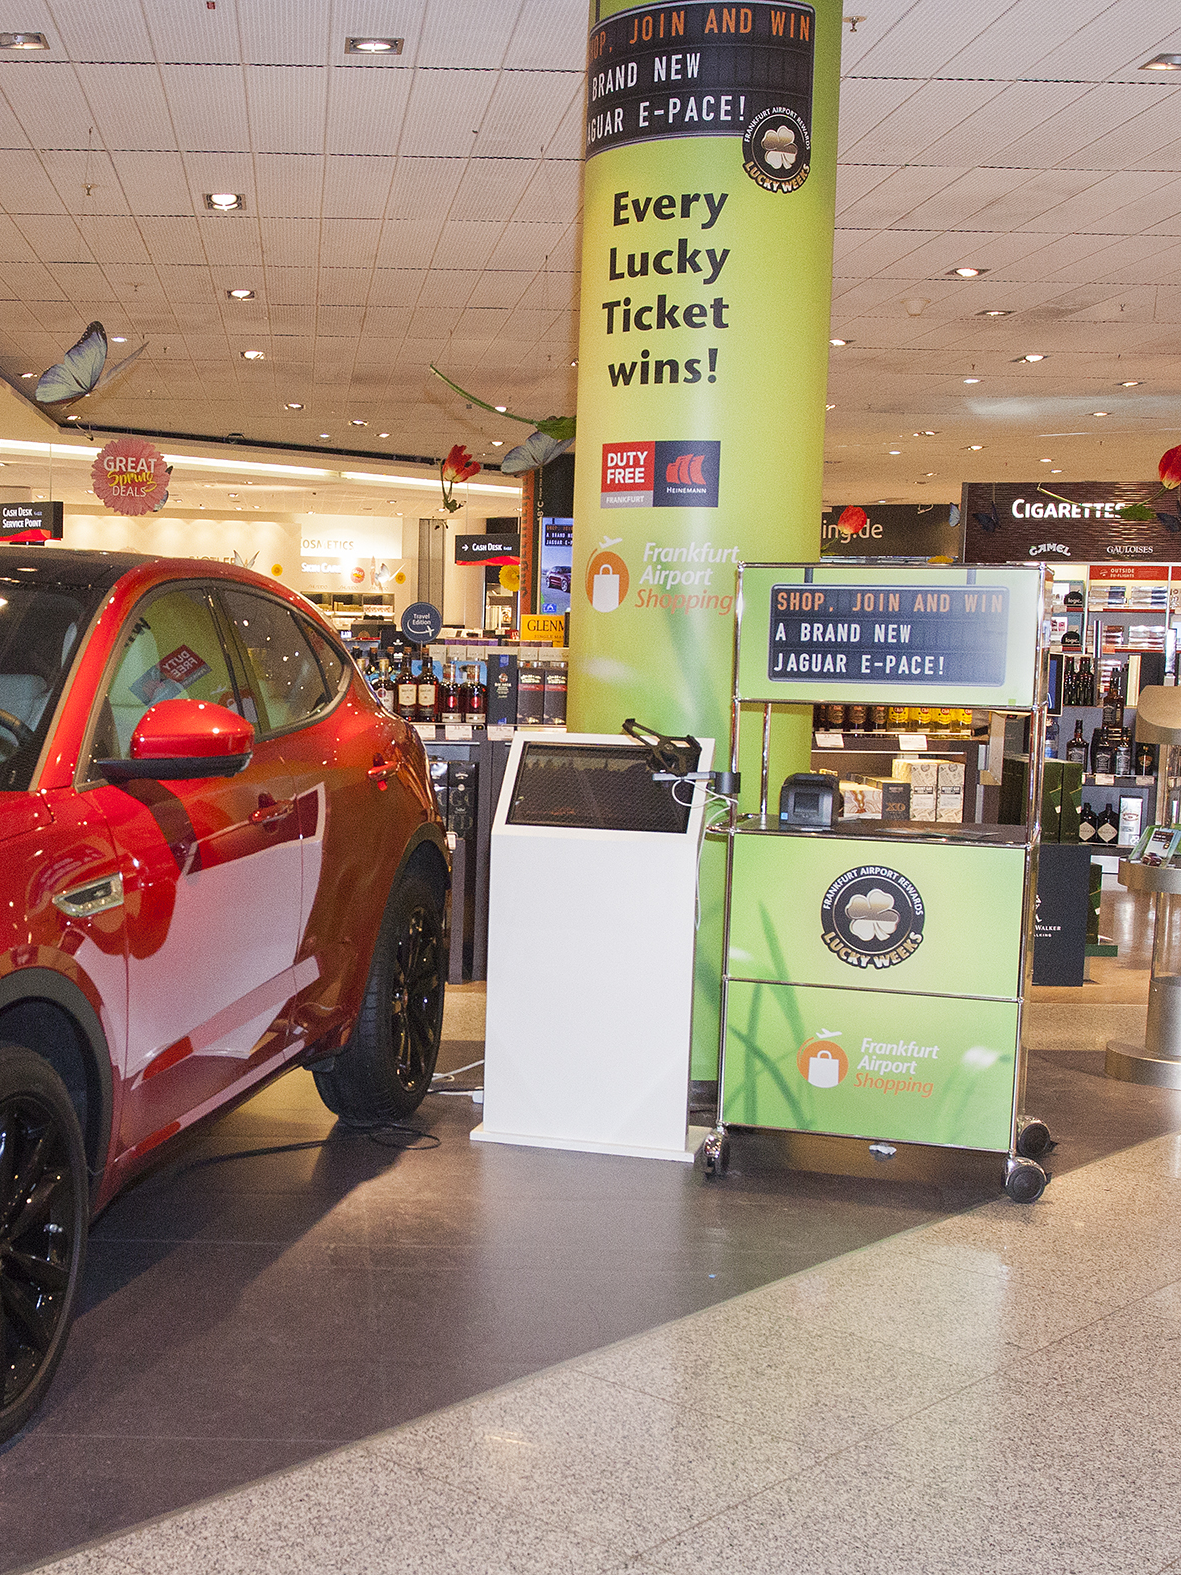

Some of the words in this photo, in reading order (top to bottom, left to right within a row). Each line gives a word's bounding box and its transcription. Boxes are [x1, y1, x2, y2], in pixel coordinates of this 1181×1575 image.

[629, 10, 685, 44] JOIN
[704, 8, 753, 34] AND
[771, 10, 810, 42] WIN
[592, 62, 637, 101] BRAND
[654, 52, 701, 82] NEW
[639, 95, 746, 127] E-PACE!
[744, 109, 771, 143] FRANKFURT
[772, 106, 798, 119] AIRPORT
[796, 116, 811, 150] REWARDS
[745, 161, 779, 192] LUCKY
[781, 163, 810, 192] WEEKS
[613, 190, 729, 229] Every
[608, 238, 730, 285] Lucky
[601, 294, 729, 335] Ticket
[607, 347, 719, 387] wins!
[104, 456, 157, 473] GREAT
[607, 451, 648, 467] DUTY
[107, 469, 158, 493] Spring
[606, 467, 645, 484] FREE
[112, 485, 146, 498] DEALS
[606, 495, 644, 504] FRANKFURT
[666, 486, 707, 494] HEINEMANN
[3, 507, 17, 517] CASH
[18, 507, 33, 517] DESK
[1011, 498, 1126, 519] CIGARETTES
[3, 519, 24, 528] SERVICE
[24, 519, 42, 528] POINT
[472, 543, 487, 551] CASH
[488, 543, 503, 551] DESK
[642, 542, 740, 564] Frankfurt
[1028, 543, 1071, 556] CAMEL
[1106, 545, 1154, 554] GAULOISES
[301, 562, 321, 573] SKIN
[321, 562, 341, 574] CARE
[639, 564, 713, 590] Airport
[634, 588, 733, 616] Shopping
[777, 592, 835, 612] SHOP,
[852, 593, 900, 612] JOIN
[914, 594, 950, 613] AND
[964, 594, 1003, 613] WIN
[775, 622, 786, 641] A
[800, 623, 861, 643] BRAND
[874, 624, 912, 643] NEW
[774, 653, 847, 673] JAGUAR
[861, 654, 945, 675] E-PACE!
[823, 869, 858, 909] FRANKFURT
[860, 866, 900, 880] AIRPORT
[897, 876, 923, 916] REWARDS
[823, 931, 871, 967] LUCKY
[873, 931, 923, 968] WEEKS
[860, 1037, 940, 1059] Frankfurt
[856, 1055, 917, 1076] Airport
[853, 1072, 934, 1099] Shopping
